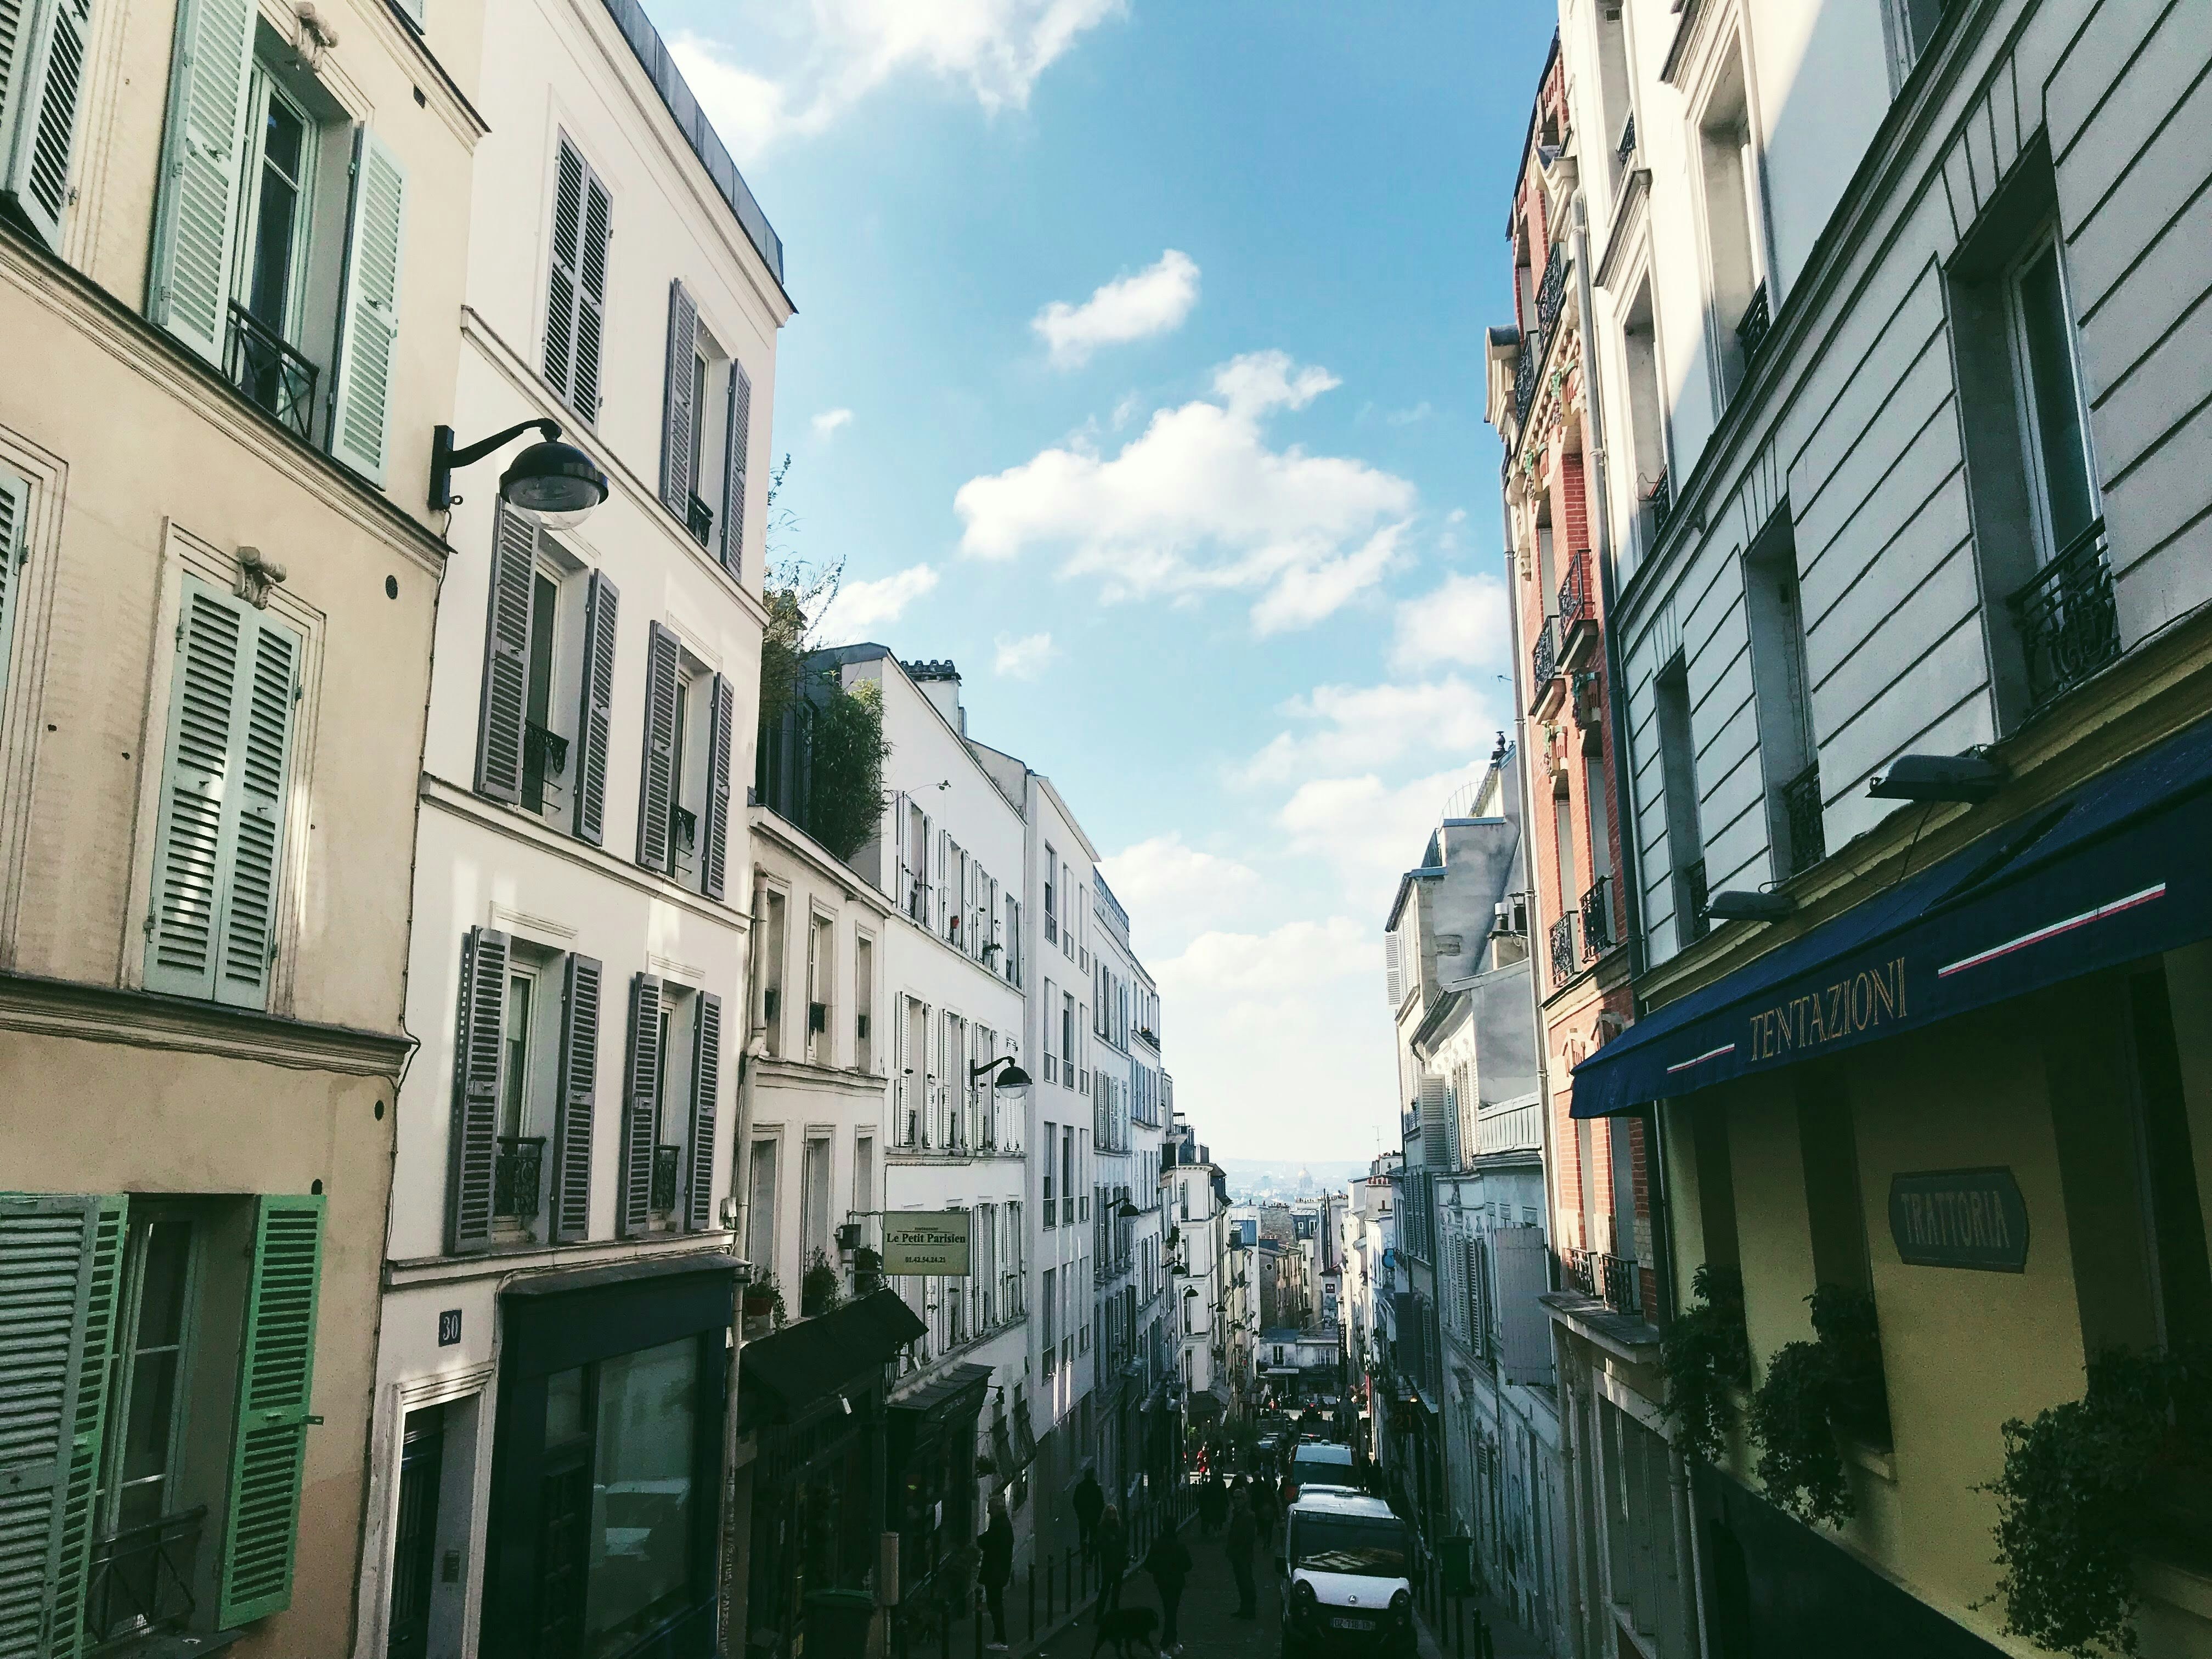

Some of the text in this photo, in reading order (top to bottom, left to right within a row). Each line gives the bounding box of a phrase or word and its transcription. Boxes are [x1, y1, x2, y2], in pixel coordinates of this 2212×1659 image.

[1750, 957, 1908, 1062] TENTAZIONI
[886, 1233, 966, 1243] Le Petit Parisien
[1900, 1190, 2011, 1249] TRATTORIA
[443, 1314, 459, 1340] 30
